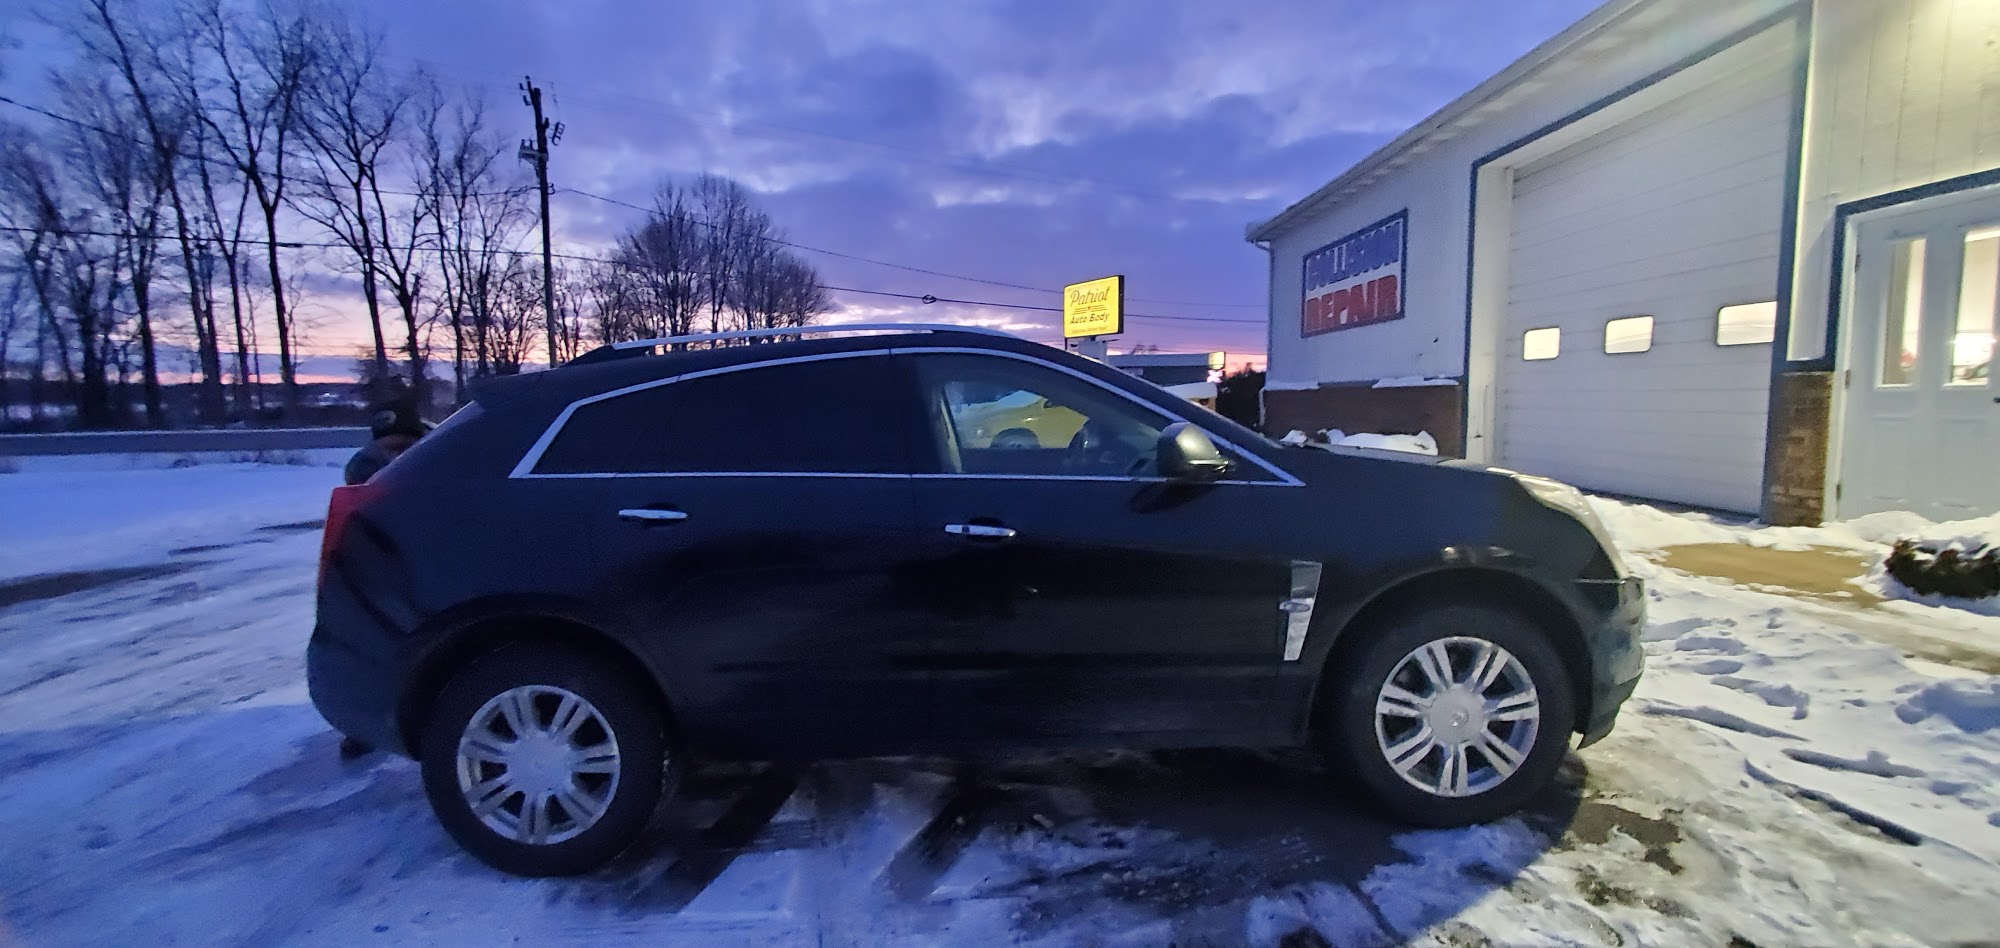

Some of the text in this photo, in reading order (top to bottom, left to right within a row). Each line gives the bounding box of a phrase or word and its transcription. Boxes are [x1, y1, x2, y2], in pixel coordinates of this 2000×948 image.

[1070, 286, 1111, 307] Patriot
[1306, 274, 1398, 332] REPAIR
[1070, 312, 1110, 324] Auto Body
